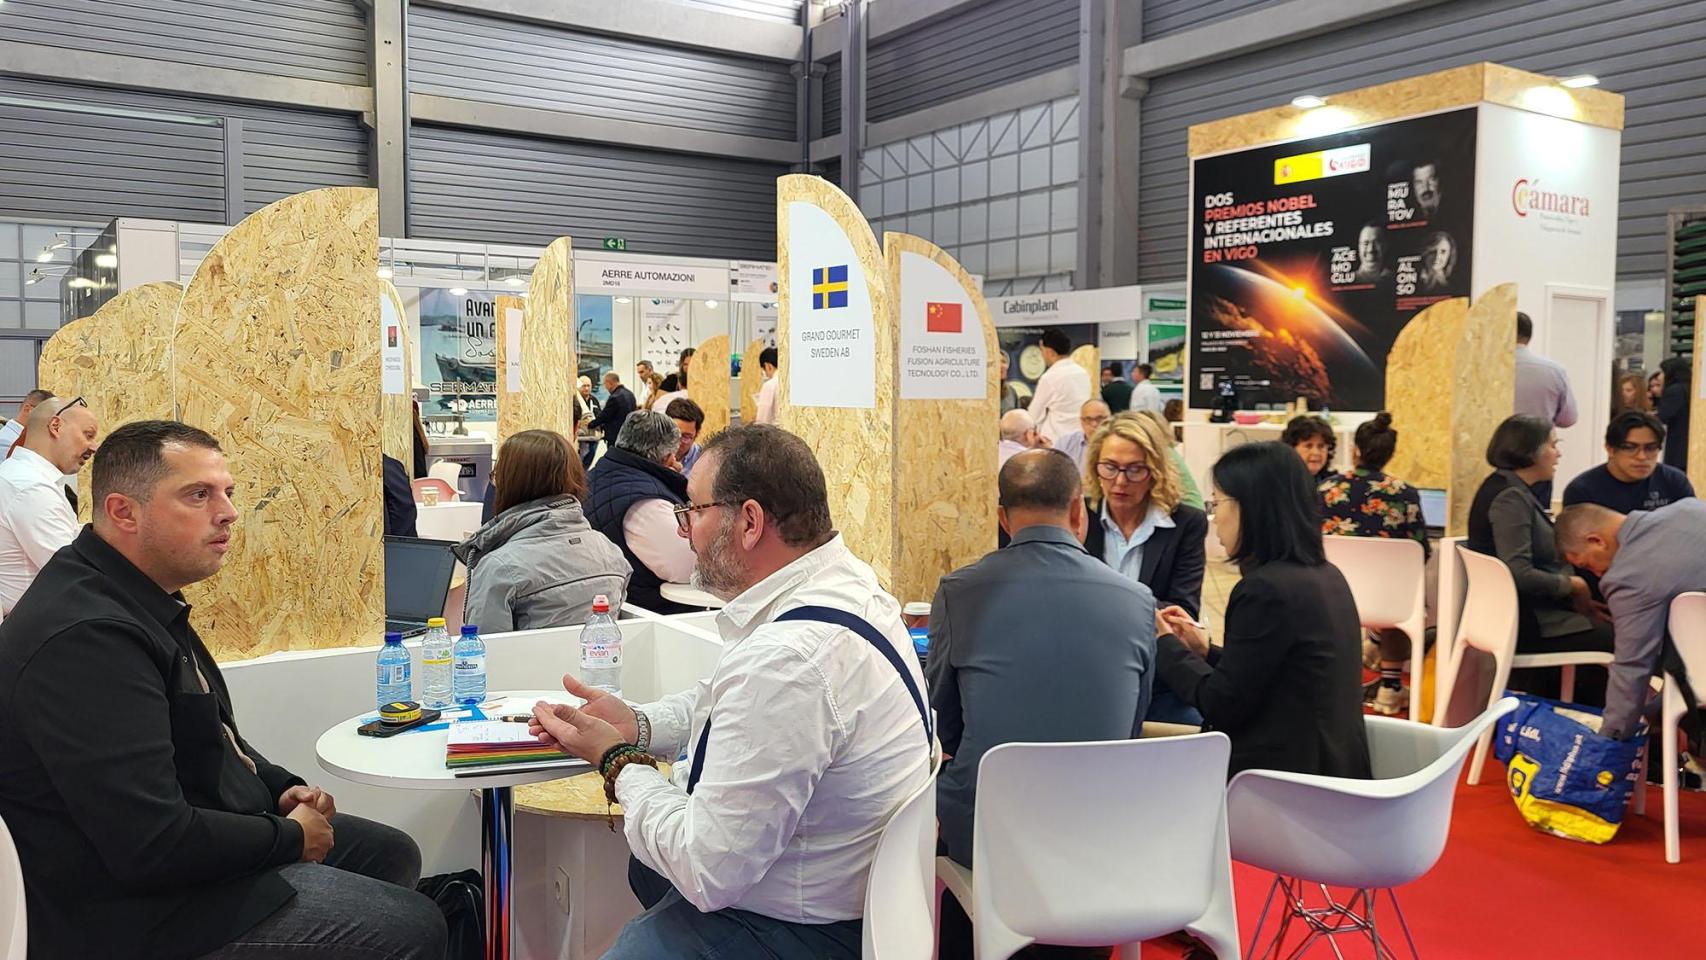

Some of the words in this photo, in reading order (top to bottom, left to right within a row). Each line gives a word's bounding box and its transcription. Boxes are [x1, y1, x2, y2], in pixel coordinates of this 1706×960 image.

[1387, 187, 1410, 199] MU
[1205, 192, 1234, 208] DOS
[1387, 199, 1406, 210] RA
[1205, 202, 1264, 222] PREMIOS
[1267, 194, 1317, 213] NOBEL
[1387, 208, 1415, 221] TOV
[1204, 222, 1214, 235] Y
[1215, 210, 1303, 234] REFERENTES
[1204, 221, 1334, 249] INTERNACIONALES
[1204, 249, 1222, 263] EN
[1224, 245, 1258, 261] VIGO
[1331, 250, 1357, 262] ACE
[1331, 262, 1352, 273] MO
[1398, 261, 1416, 272] AL
[602, 269, 633, 280] AERRE
[634, 271, 695, 282] AUTOMAZIONI
[1331, 272, 1356, 284] GLU
[1396, 272, 1418, 283] ON
[1396, 283, 1416, 295] SO
[1003, 298, 1059, 315] Cabinplant
[802, 331, 825, 341] GRAND
[826, 329, 860, 341] GOURMET
[811, 347, 840, 358] SWEDEN
[841, 346, 850, 358] AB
[913, 345, 942, 354] FOSHAN
[943, 346, 976, 355] FISHERIES
[907, 357, 933, 366] FUSION
[934, 358, 980, 367] AGRICULTURE
[907, 369, 949, 378] TECNOLOGY
